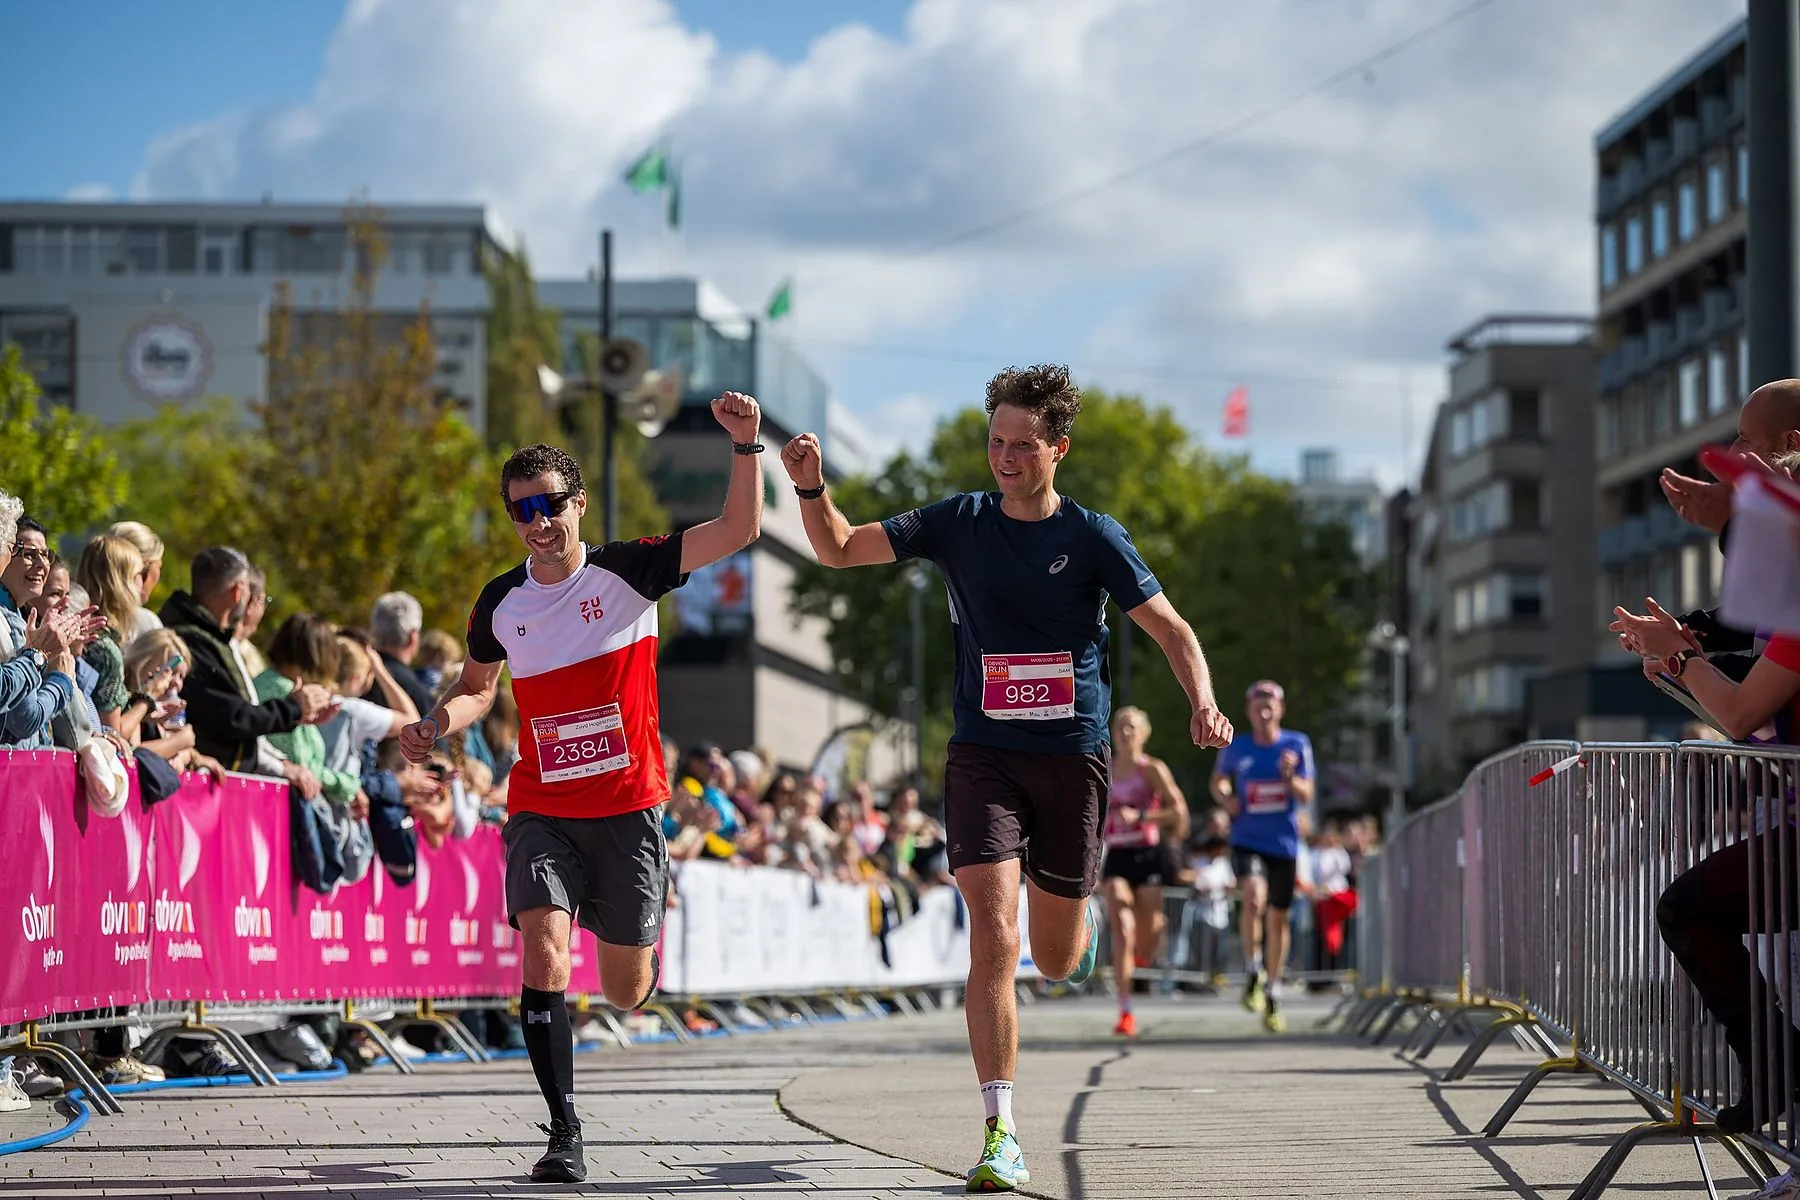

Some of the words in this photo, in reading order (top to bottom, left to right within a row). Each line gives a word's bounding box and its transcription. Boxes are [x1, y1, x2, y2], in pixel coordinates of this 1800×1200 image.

[1005, 684, 1051, 704] 982
[539, 727, 556, 736] RUN
[553, 736, 610, 764] 2384
[101, 889, 146, 936] obvion
